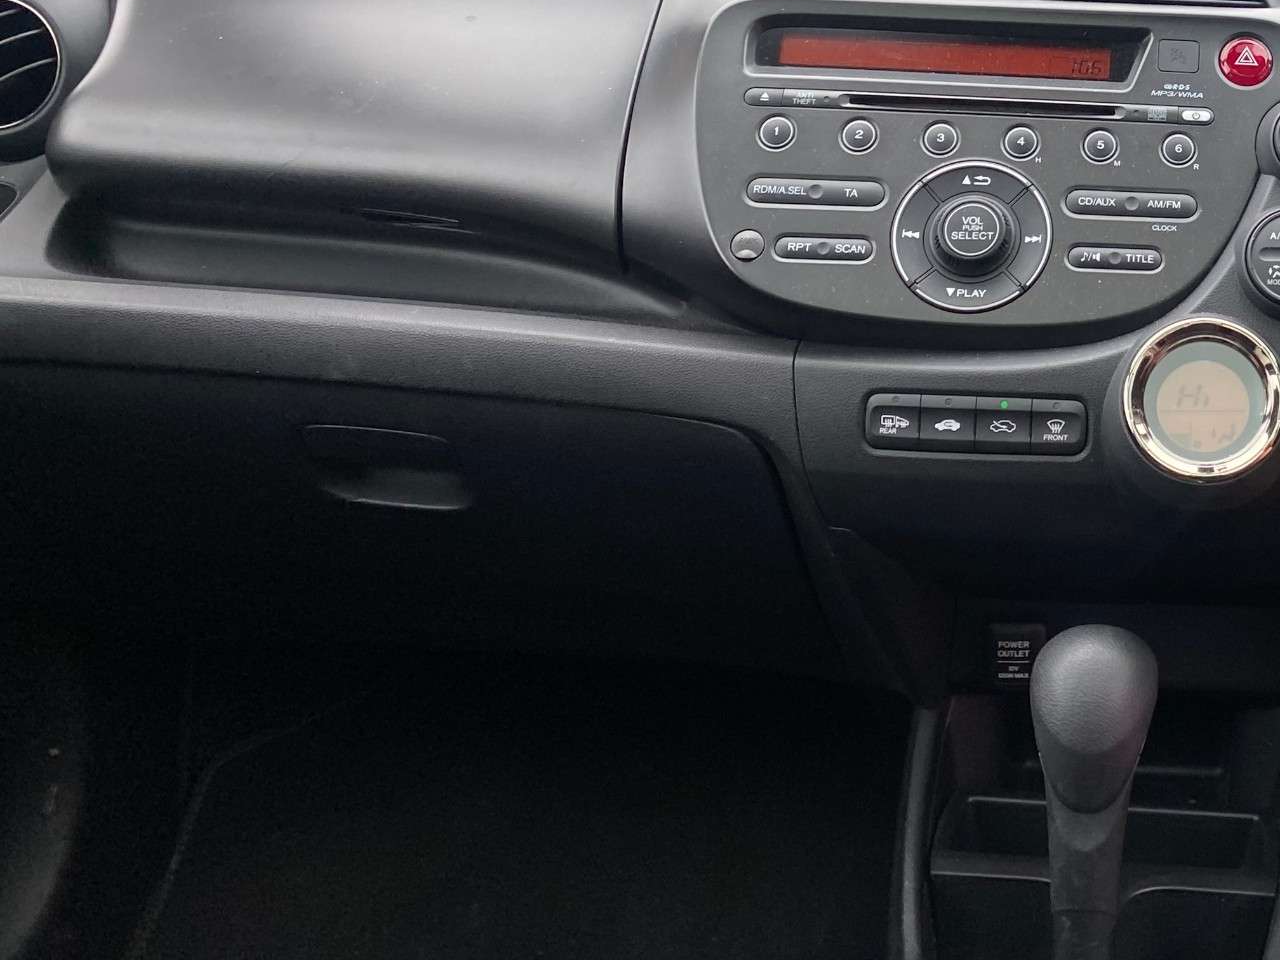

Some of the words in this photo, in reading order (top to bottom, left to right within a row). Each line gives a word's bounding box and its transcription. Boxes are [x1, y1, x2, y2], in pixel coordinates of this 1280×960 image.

[1151, 90, 1204, 99] MP3/WMA
[792, 97, 817, 105] THEFT
[774, 127, 780, 136] 1
[854, 130, 864, 139] 2
[936, 133, 945, 142] 3
[1016, 136, 1025, 146] 4
[1096, 140, 1105, 150] 5
[1174, 143, 1183, 153] 6
[844, 188, 858, 198] TA
[1078, 197, 1116, 208] CD/AUX
[1147, 199, 1182, 210] AM/FM
[962, 216, 983, 225] VOL
[1152, 224, 1177, 232] CLOCK
[951, 231, 994, 241] SELECT
[787, 242, 812, 252] RPT
[835, 244, 866, 254] SCAN
[1125, 254, 1155, 264] TITLE
[956, 288, 987, 299] PLAY
